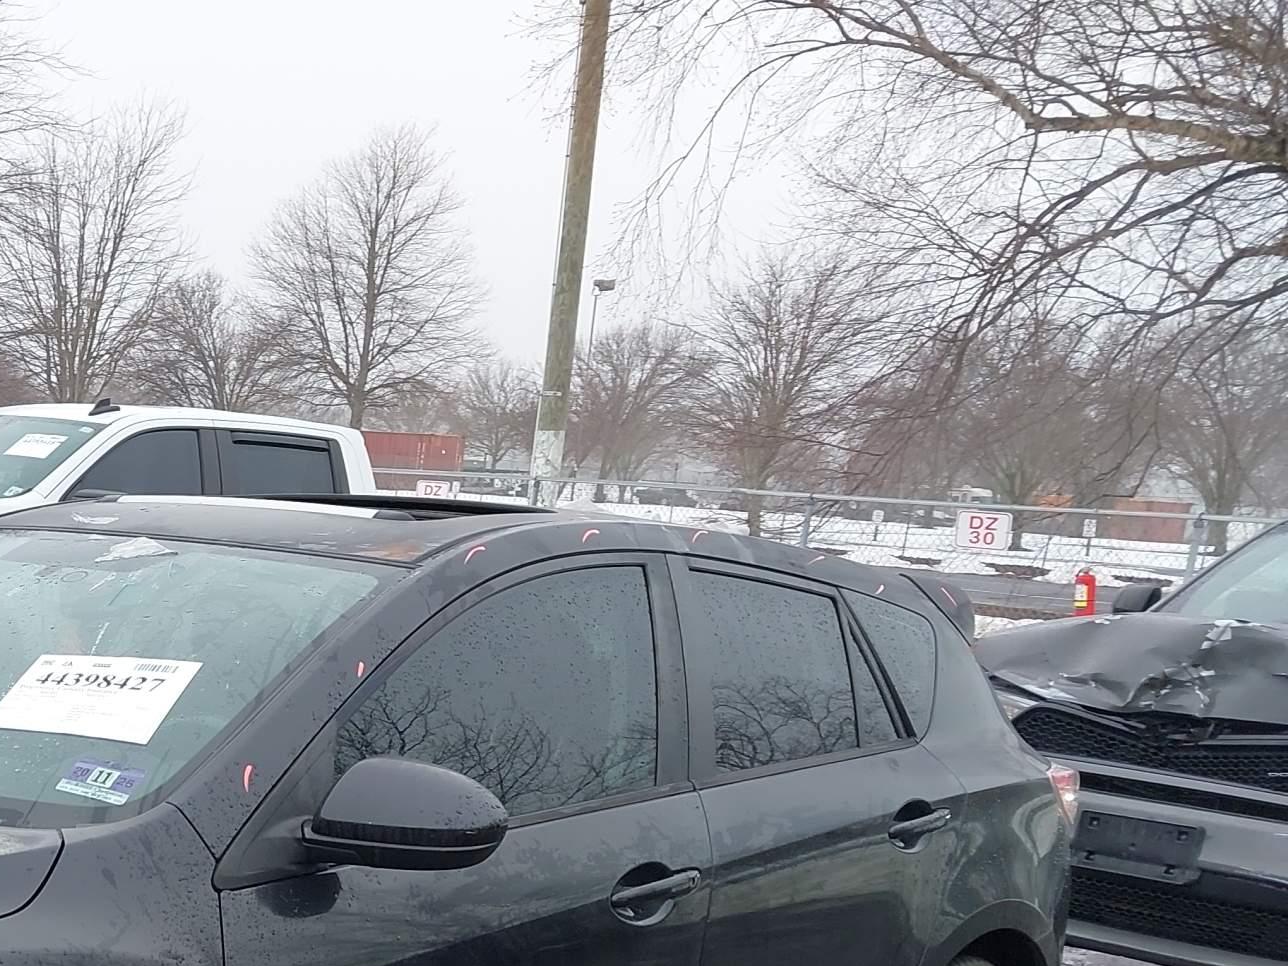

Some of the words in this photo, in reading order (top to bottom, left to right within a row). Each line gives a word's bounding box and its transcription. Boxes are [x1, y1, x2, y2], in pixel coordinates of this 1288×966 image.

[424, 485, 442, 496] DZ
[969, 516, 999, 531] DZ
[969, 531, 995, 545] 30
[35, 671, 165, 692] 44398427
[92, 770, 112, 785] 11
